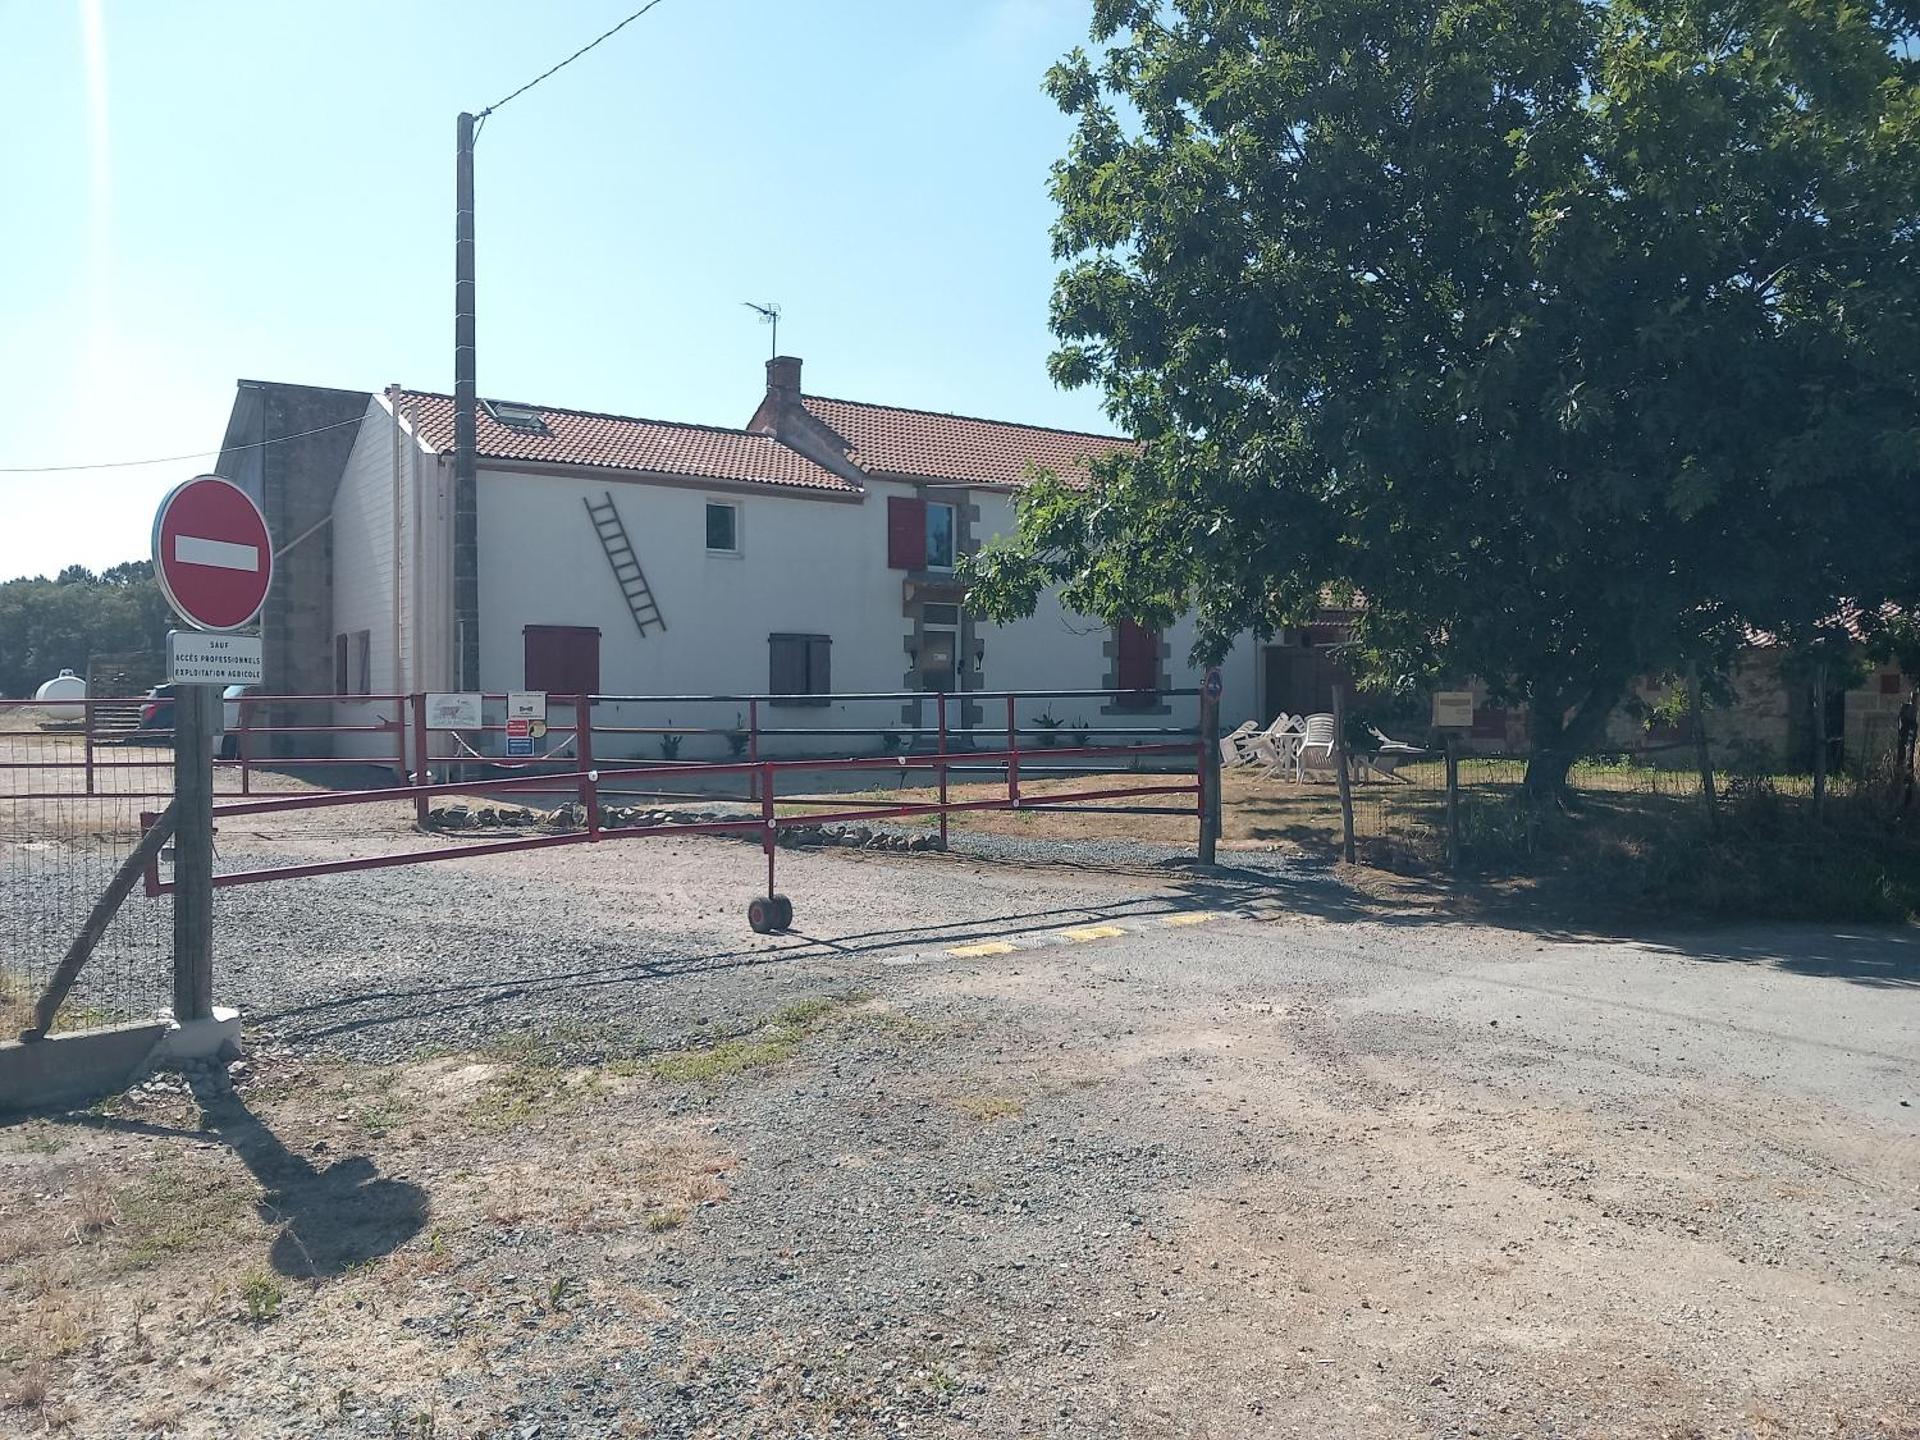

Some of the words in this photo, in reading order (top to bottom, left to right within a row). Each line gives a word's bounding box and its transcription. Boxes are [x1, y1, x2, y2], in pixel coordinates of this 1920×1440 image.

[210, 641, 229, 649] SAUF
[200, 655, 261, 665] PROFESSIONNELS
[175, 668, 225, 677] EXPLOITATION
[227, 670, 261, 678] AGRICOLE
